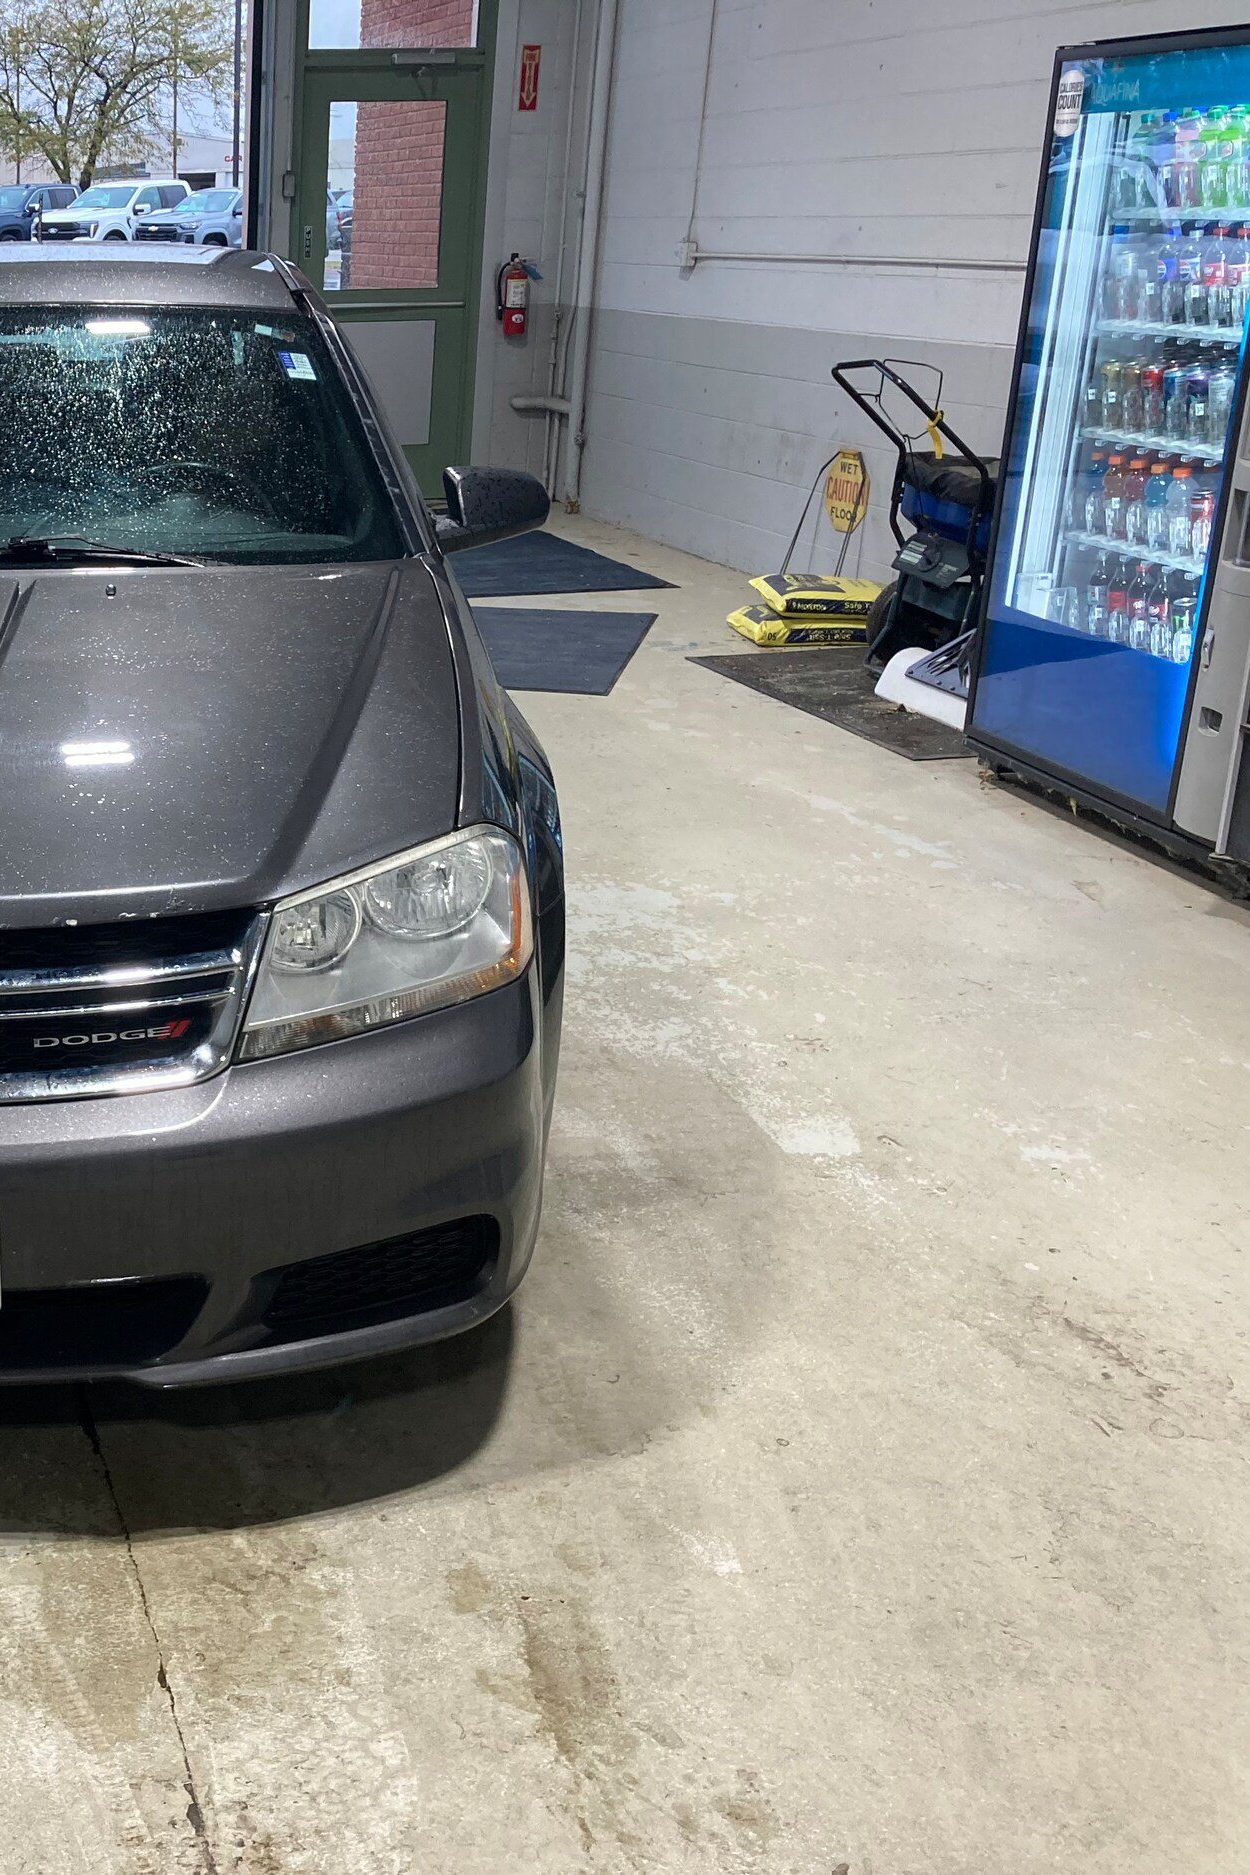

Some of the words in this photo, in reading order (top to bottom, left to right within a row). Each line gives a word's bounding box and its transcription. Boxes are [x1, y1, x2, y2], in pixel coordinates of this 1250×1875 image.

[1060, 81, 1084, 93] CALORIES
[1058, 94, 1082, 110] COUNT
[840, 461, 859, 475] WET
[830, 506, 857, 523] FLOO
[33, 1025, 171, 1048] DODGE
